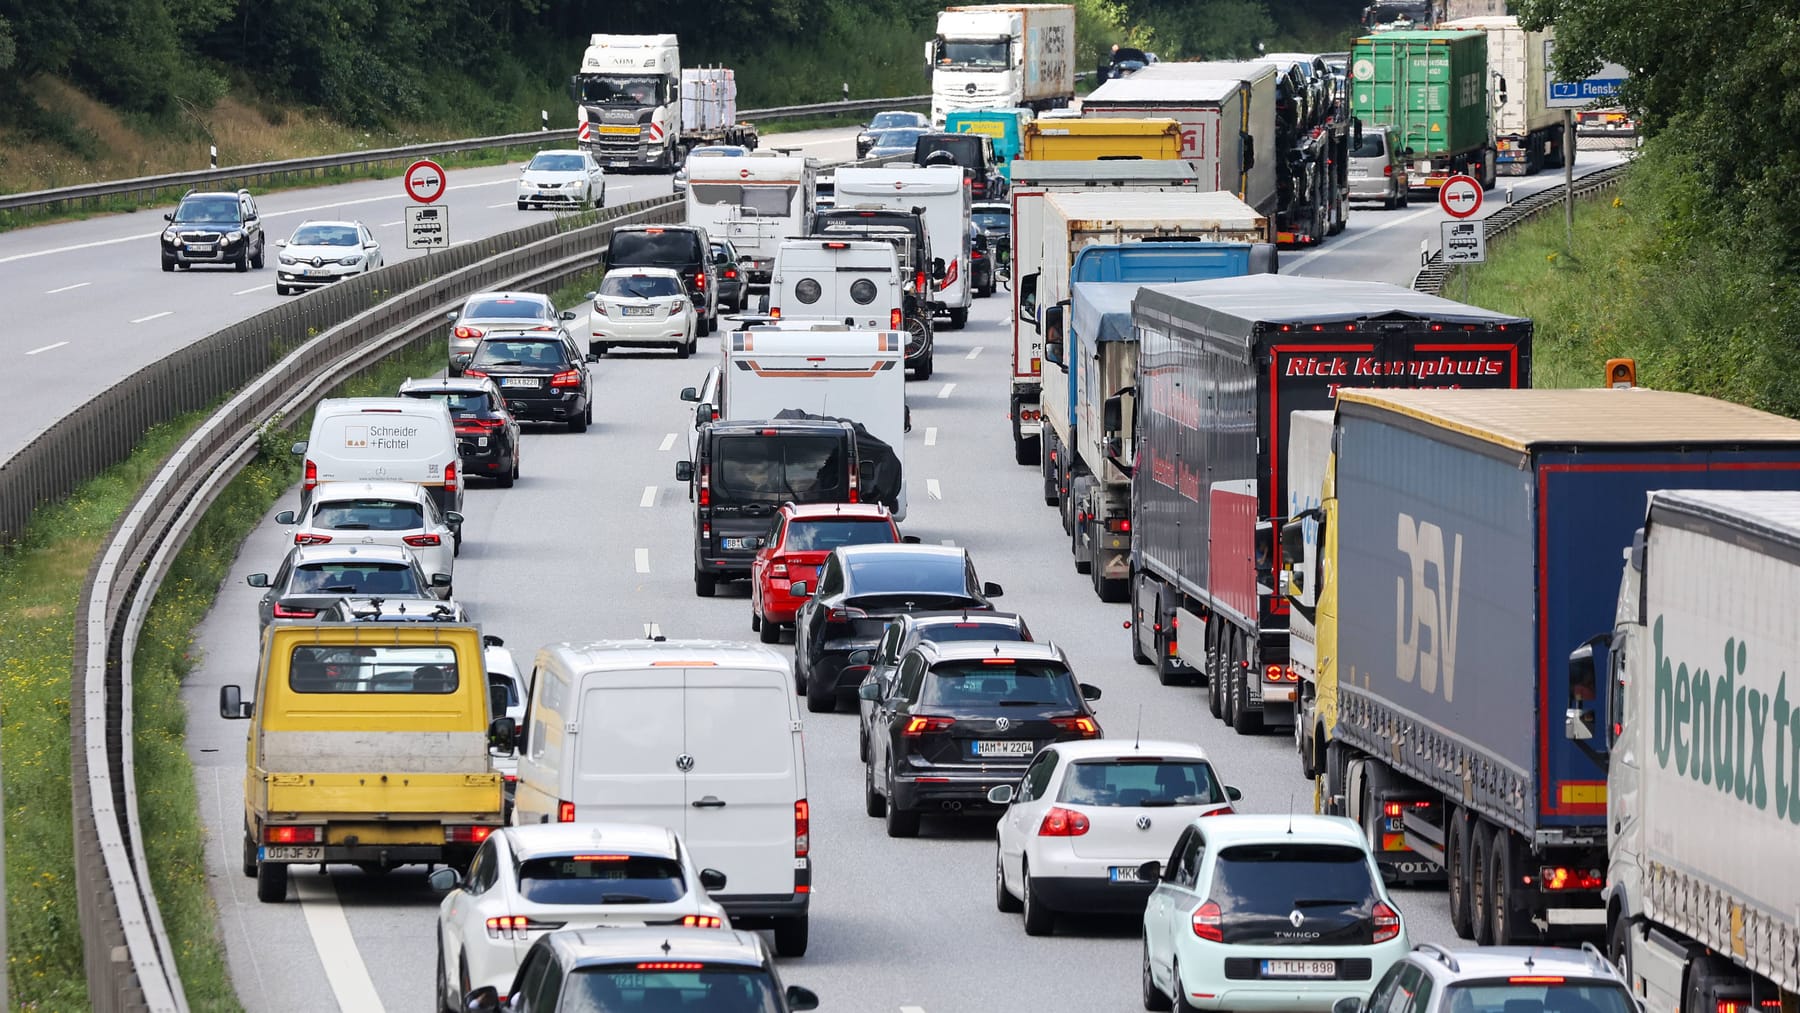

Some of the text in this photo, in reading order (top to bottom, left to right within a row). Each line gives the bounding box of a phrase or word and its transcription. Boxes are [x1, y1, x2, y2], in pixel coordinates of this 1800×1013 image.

[1562, 82, 1622, 95] 7 Flensb
[1285, 357, 1503, 379] Rick Kamphuis
[370, 426, 418, 437] Schneider
[370, 438, 409, 449] +Fichtel
[1396, 512, 1463, 703] DSV
[1653, 613, 1769, 811] bendix
[978, 742, 996, 753] HAM
[1010, 742, 1033, 753] 2204
[290, 847, 304, 858] JF
[306, 847, 320, 858] 37
[1270, 962, 1334, 973] 1-TLH-898
